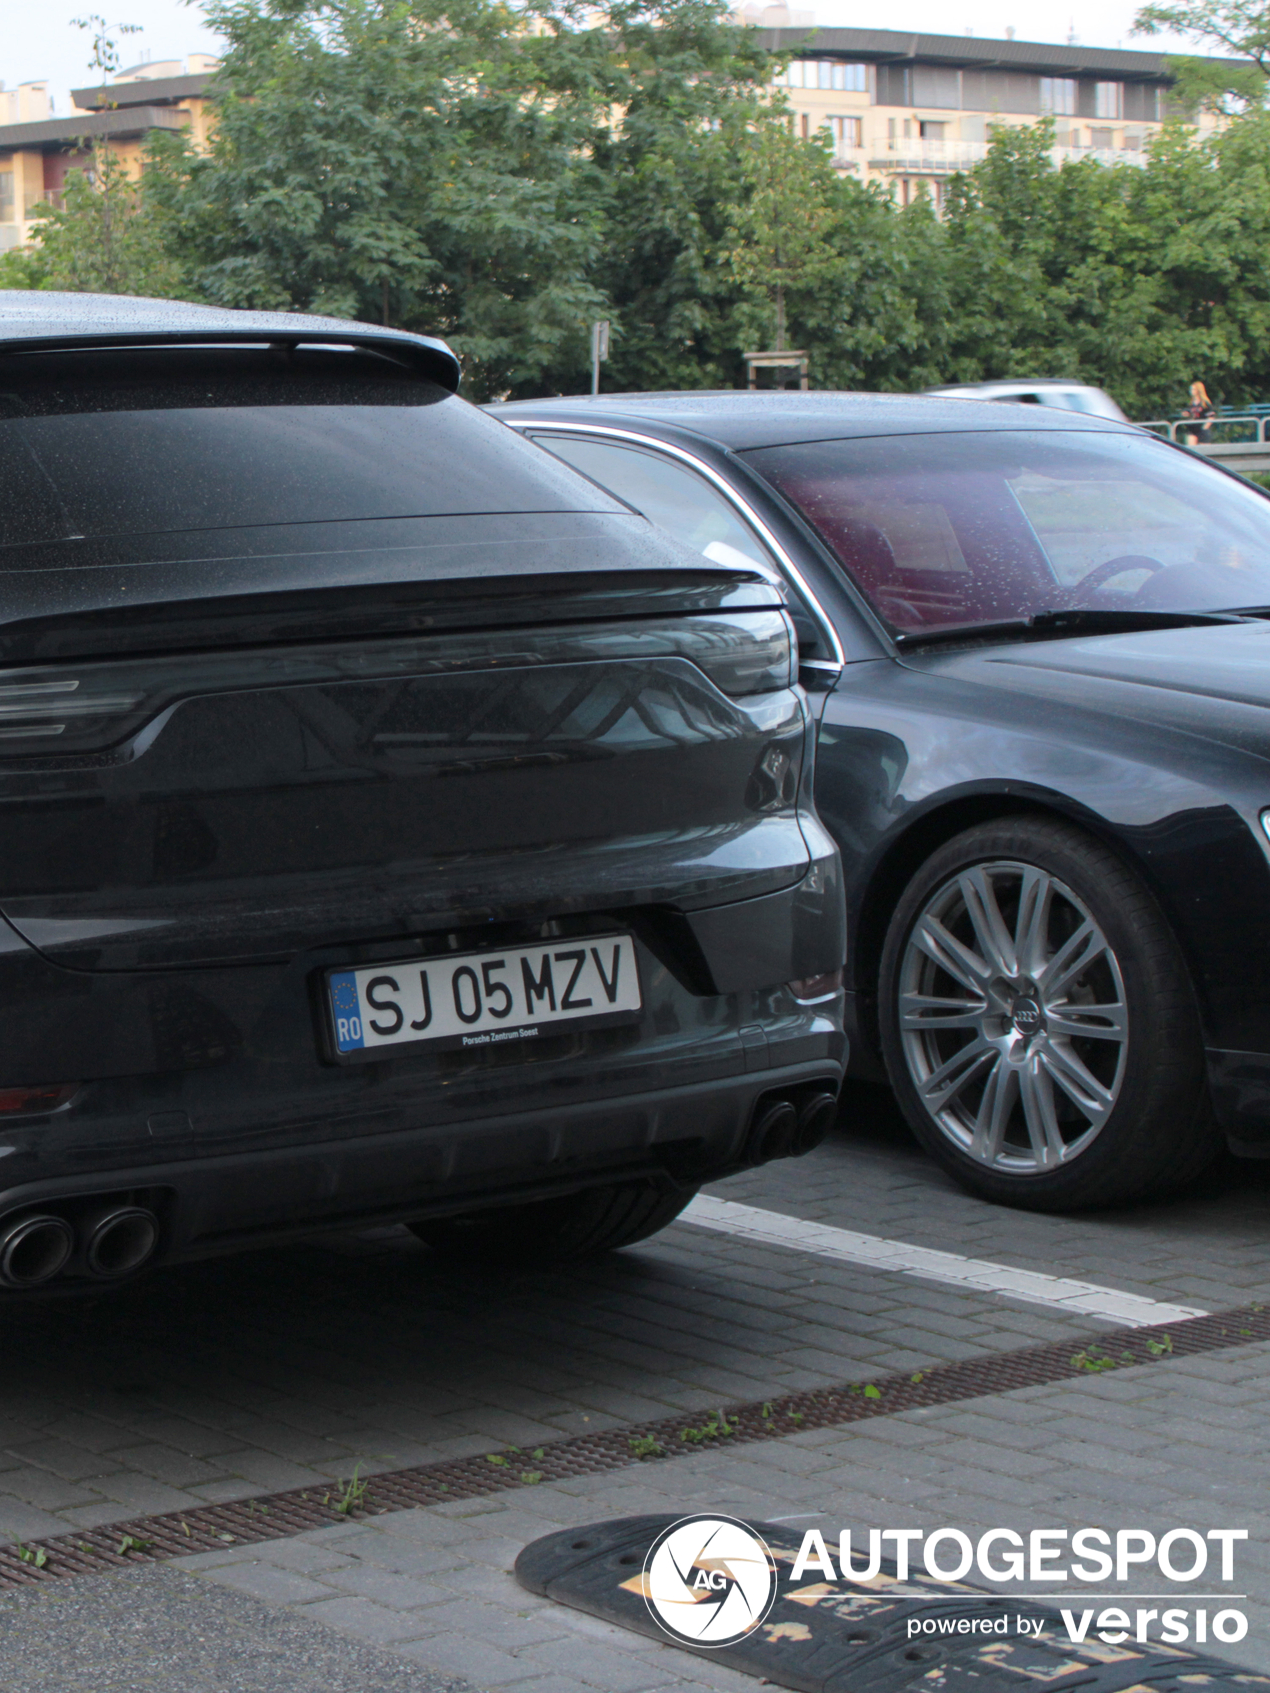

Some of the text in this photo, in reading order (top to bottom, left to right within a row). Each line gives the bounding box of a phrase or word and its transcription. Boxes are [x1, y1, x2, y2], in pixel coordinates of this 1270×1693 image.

[365, 944, 621, 1036] SJ 05 MZV
[338, 1017, 362, 1041] RO
[462, 1034, 490, 1045] Porsche
[490, 1030, 519, 1042] Zentrum
